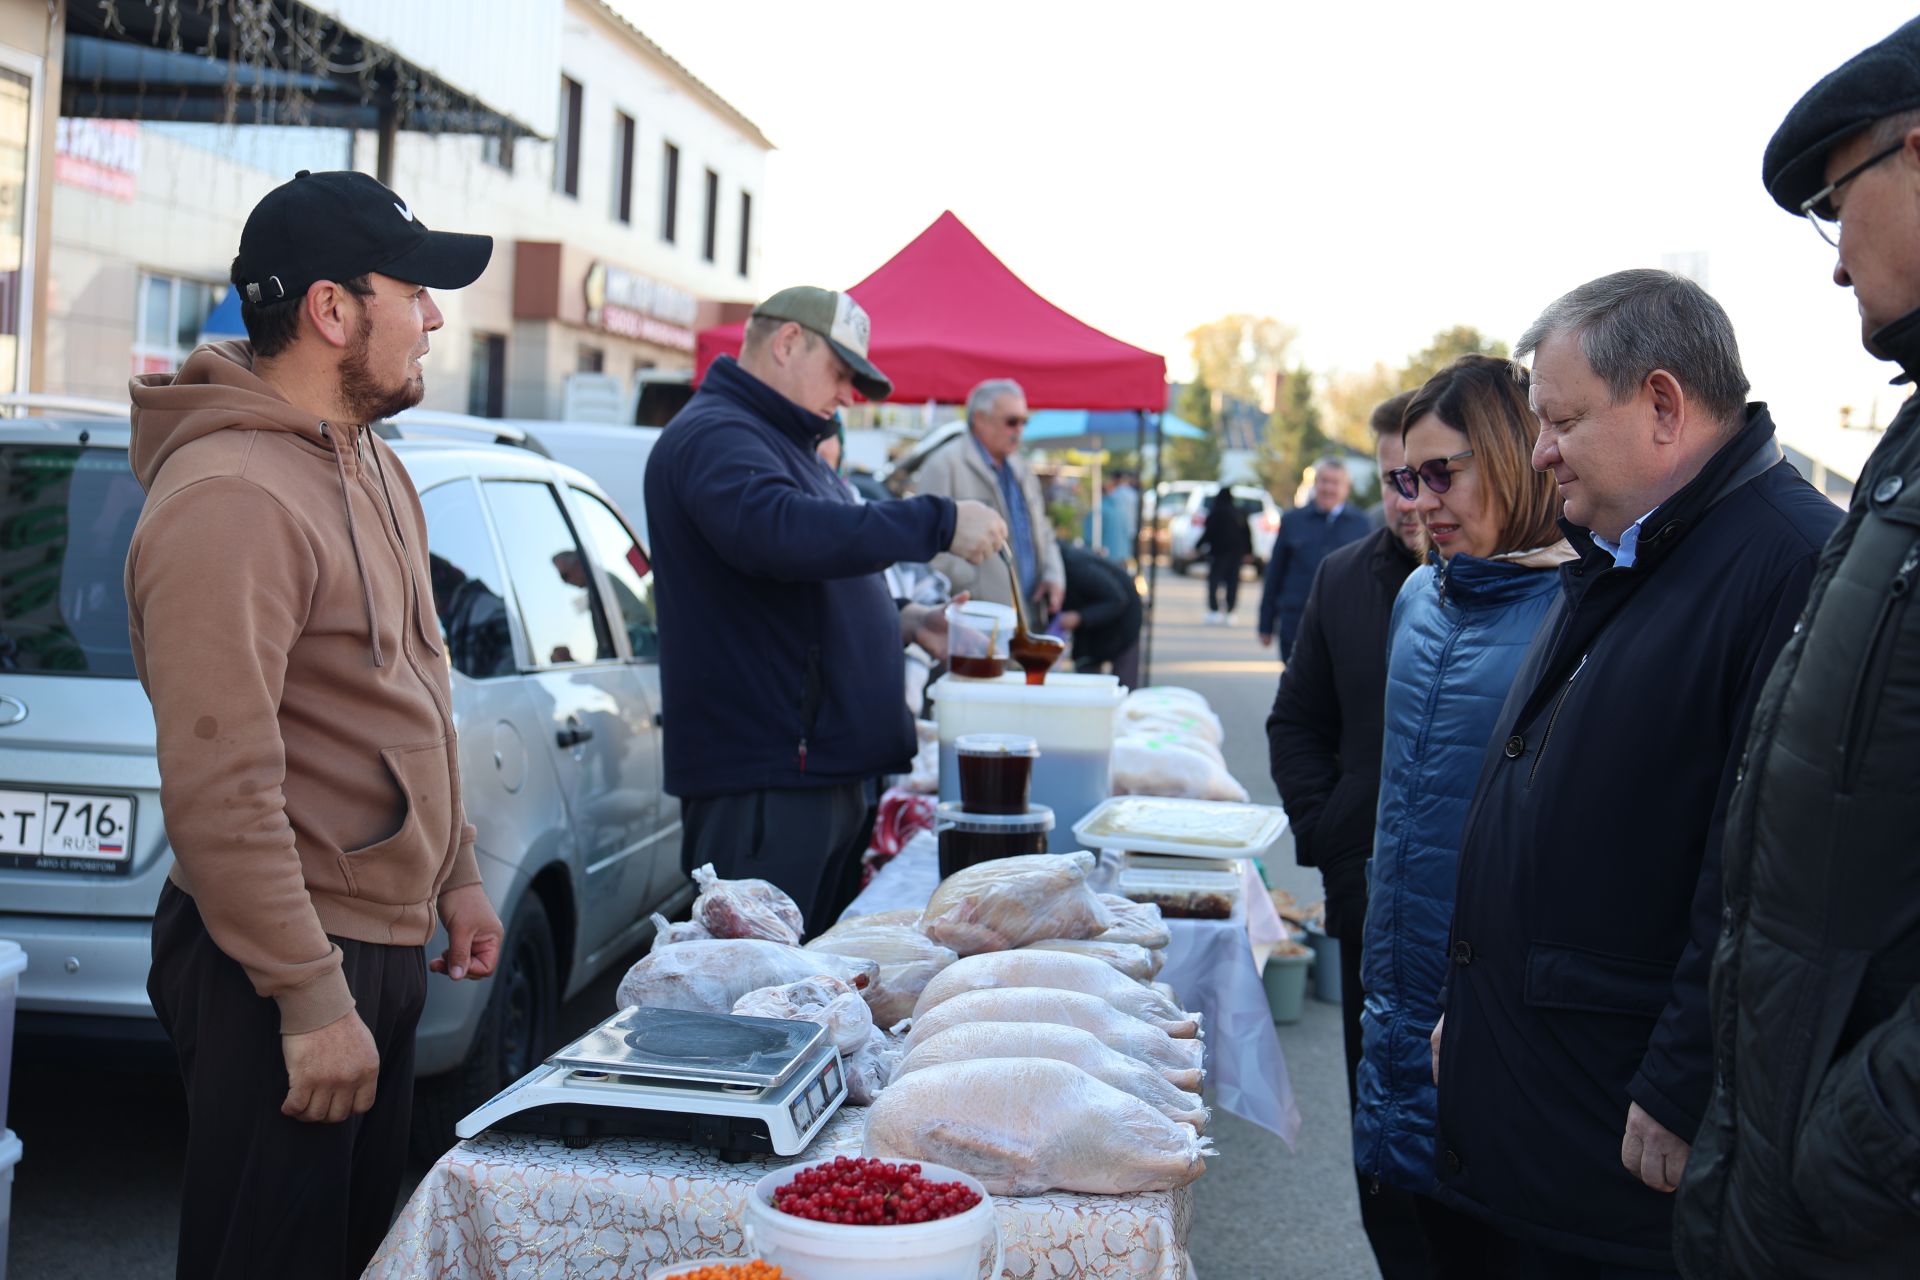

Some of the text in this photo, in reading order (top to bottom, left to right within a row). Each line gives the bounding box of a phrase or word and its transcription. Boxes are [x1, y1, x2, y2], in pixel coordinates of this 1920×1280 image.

[0, 810, 35, 845] Т
[50, 801, 116, 838] 716
[63, 837, 97, 851] RUS
